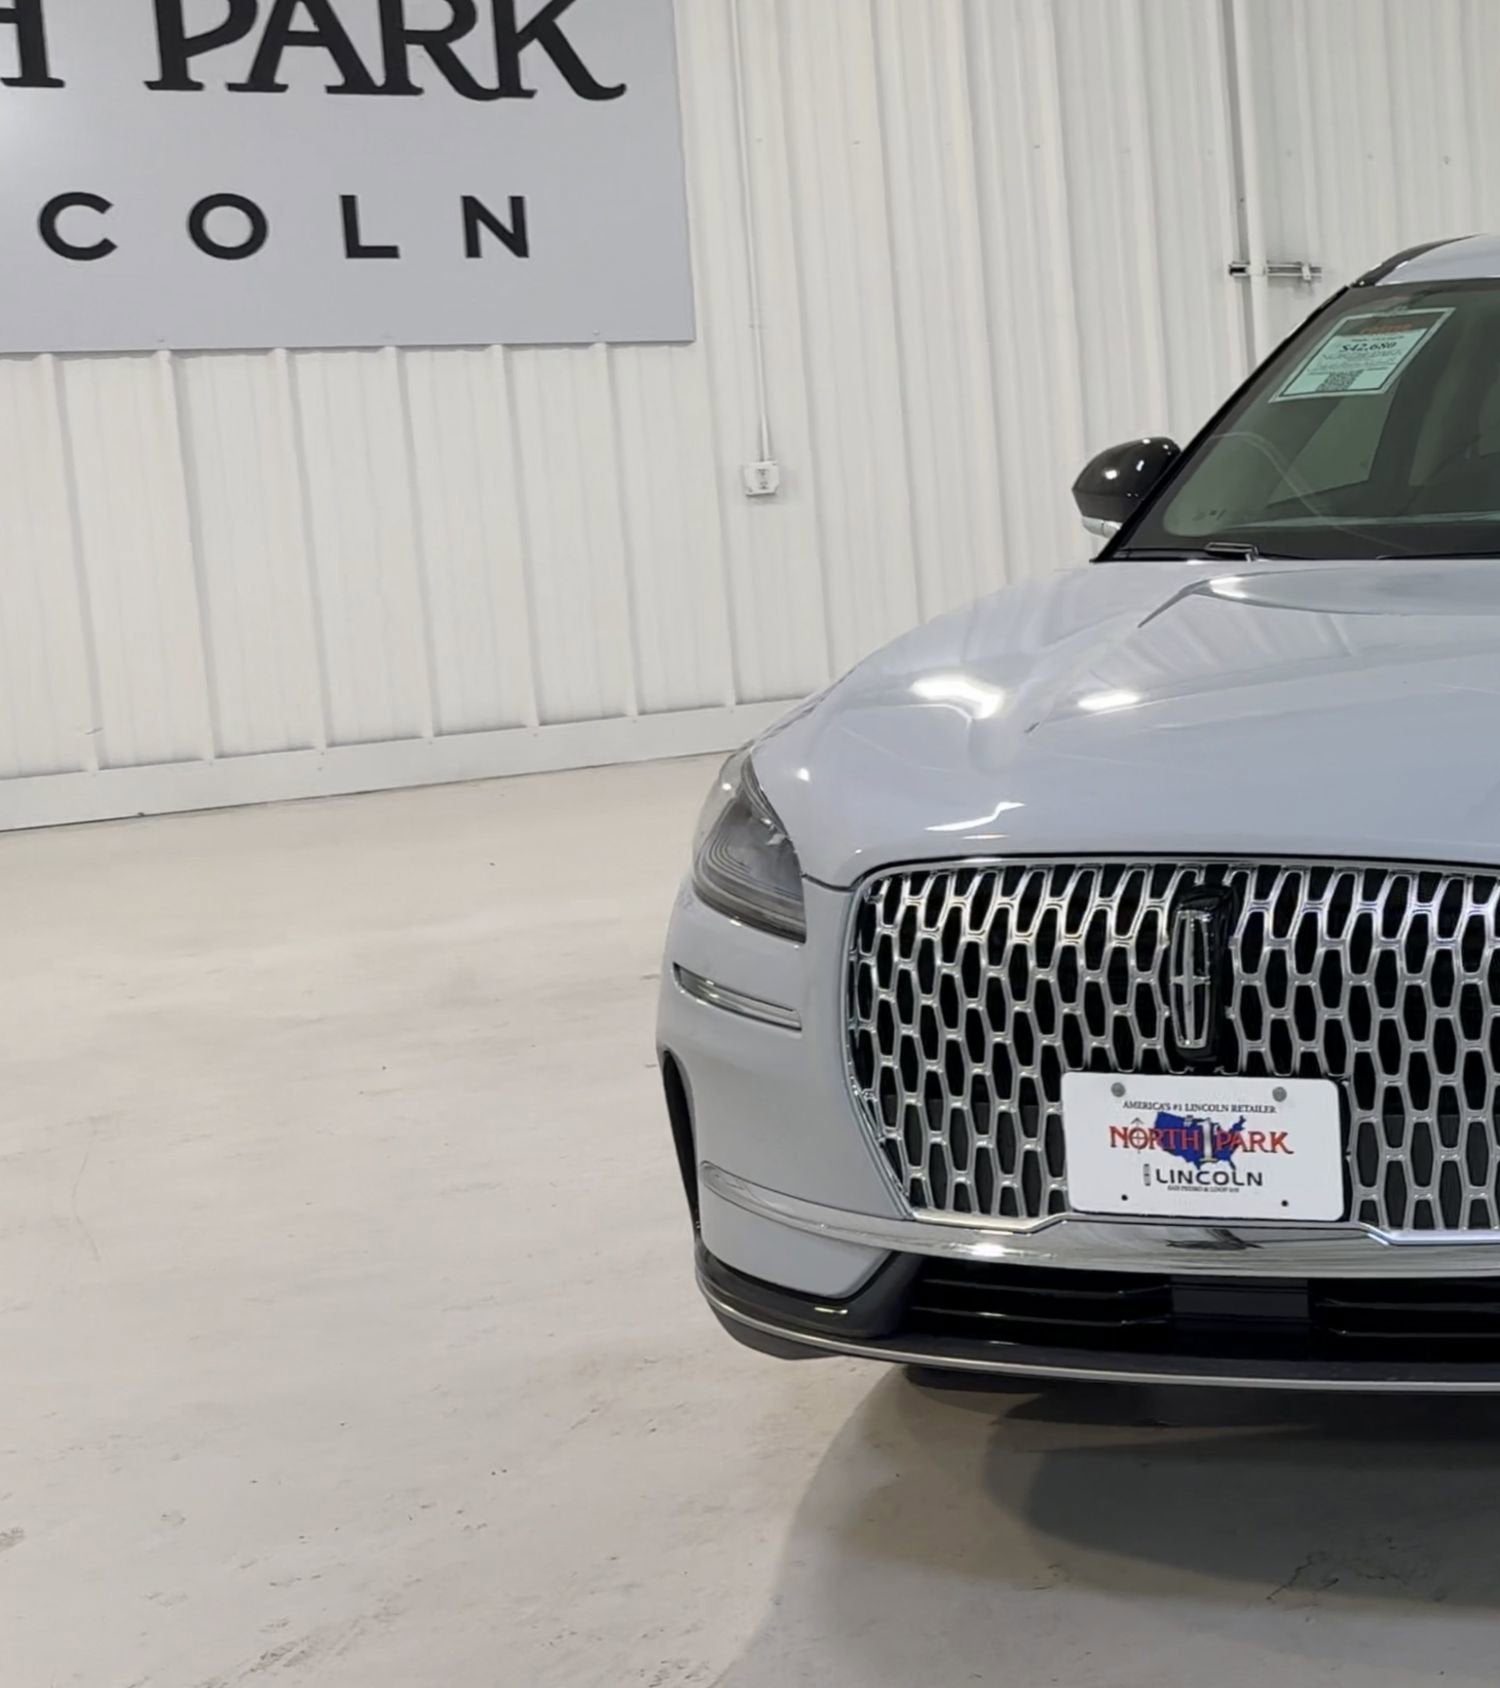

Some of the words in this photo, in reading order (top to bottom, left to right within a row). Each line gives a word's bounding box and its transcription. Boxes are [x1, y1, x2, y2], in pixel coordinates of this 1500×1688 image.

[144, 0, 627, 101] PARK
[1123, 1101, 1171, 1111] AMERICA'S
[1173, 1103, 1182, 1111] #1
[1185, 1103, 1229, 1112] LINCOLN
[1231, 1104, 1277, 1114] RETAILER
[1109, 1126, 1199, 1150] NORTH
[1216, 1129, 1294, 1154] PARK
[1155, 1168, 1263, 1187] LINCOLN
